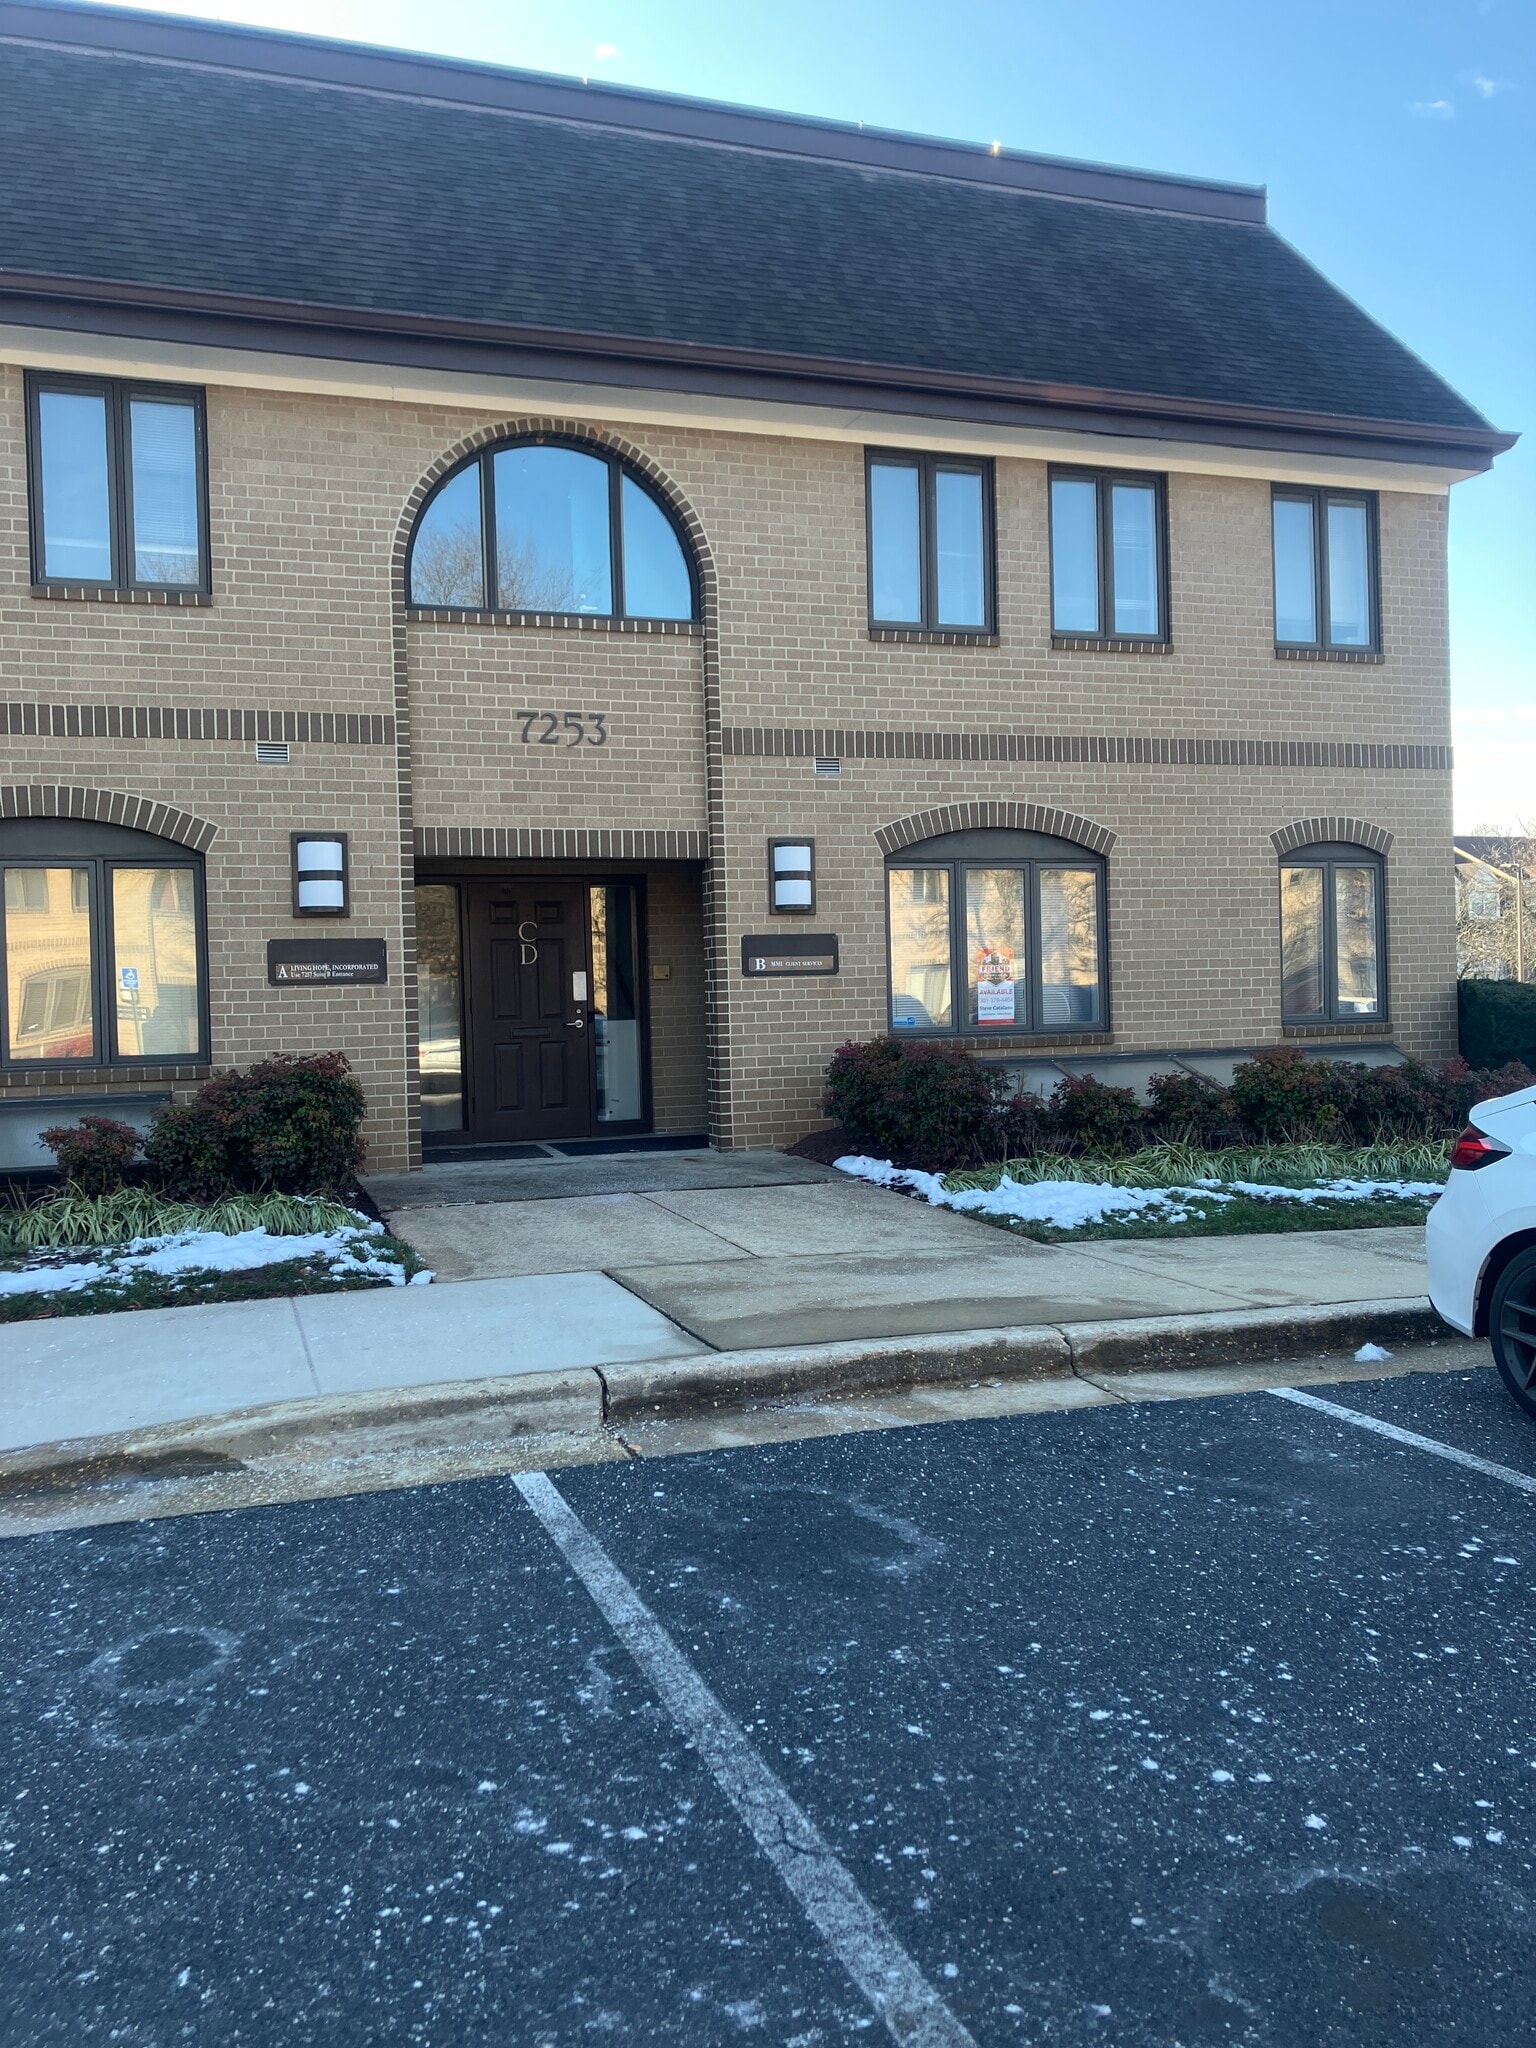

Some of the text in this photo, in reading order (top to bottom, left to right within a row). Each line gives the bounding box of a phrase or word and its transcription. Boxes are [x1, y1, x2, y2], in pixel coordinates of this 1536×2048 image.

[516, 711, 607, 747] 7253
[518, 921, 538, 942] C
[520, 944, 538, 965] D
[278, 965, 288, 978] A
[332, 963, 379, 971] INCORPORATED
[755, 958, 766, 970] B
